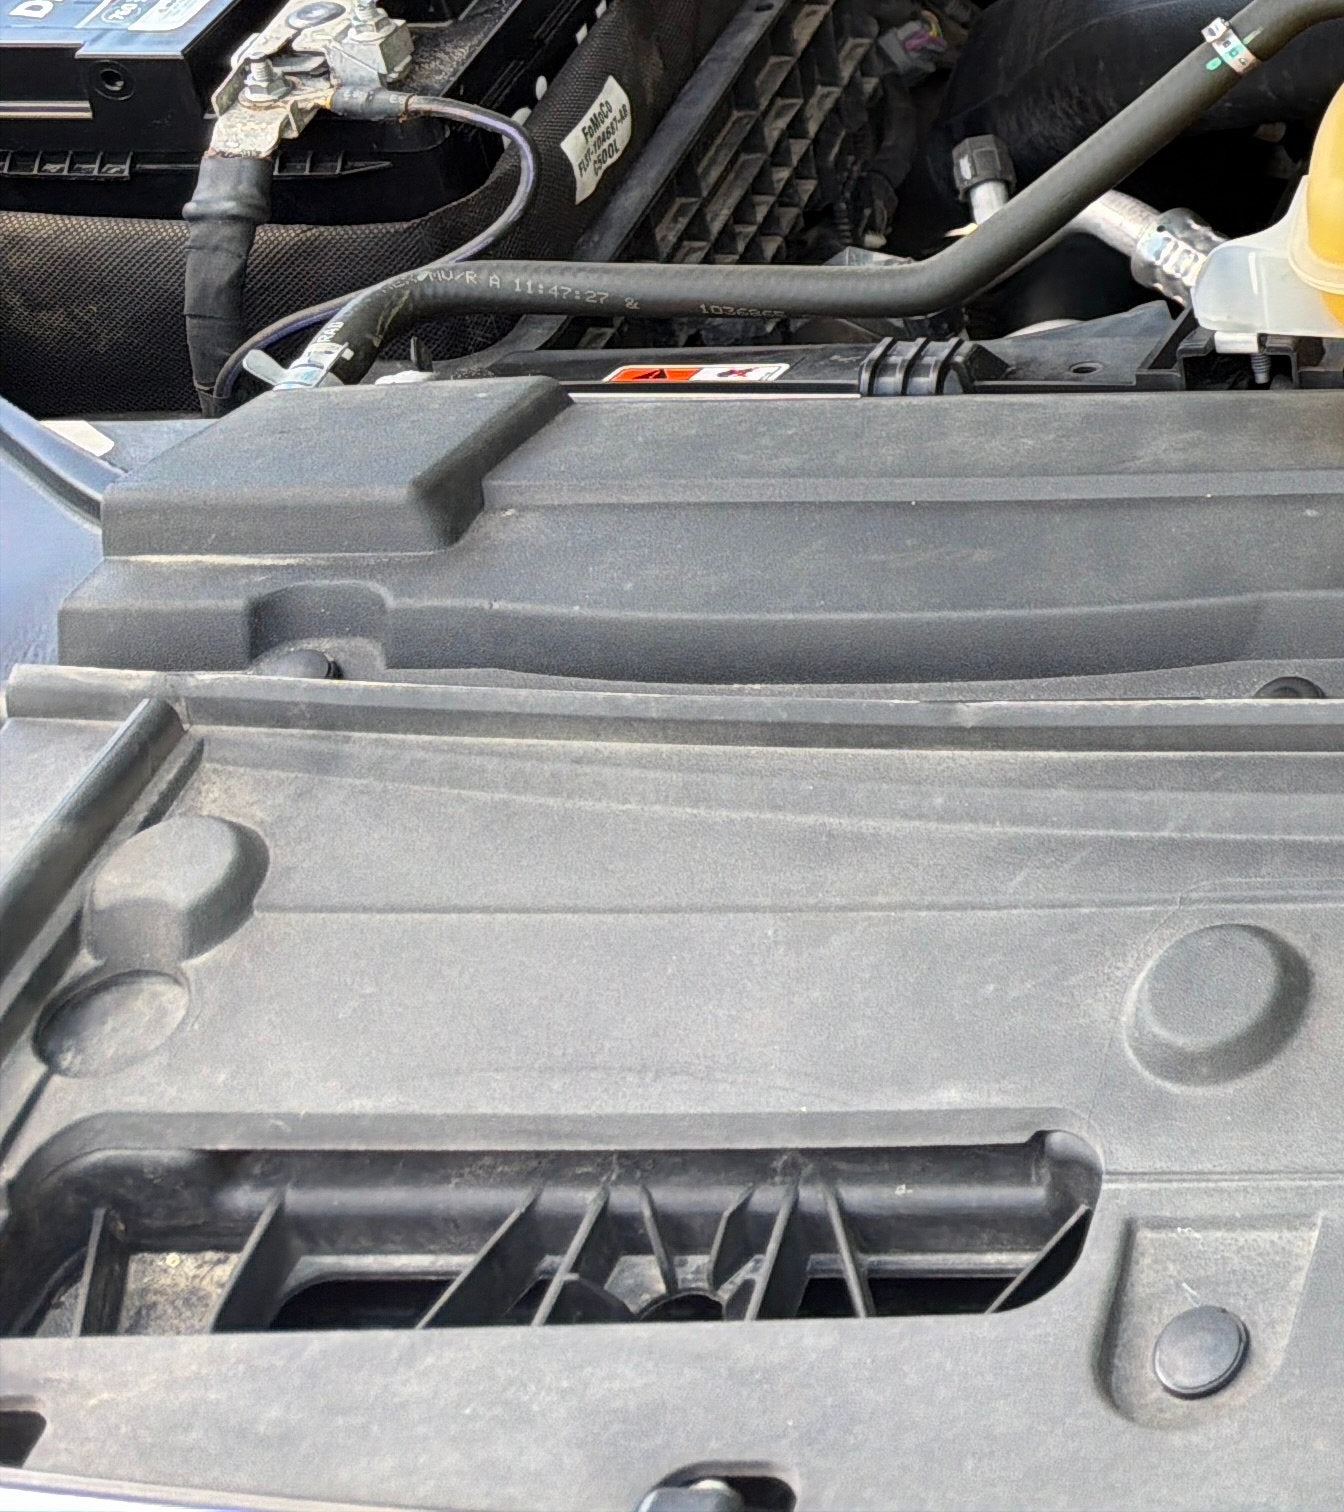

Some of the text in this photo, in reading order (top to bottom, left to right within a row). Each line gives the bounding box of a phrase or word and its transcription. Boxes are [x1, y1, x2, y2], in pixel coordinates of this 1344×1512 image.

[581, 100, 613, 144] FoMoCo
[488, 273, 501, 289] A
[514, 276, 609, 305] 11:47:27
